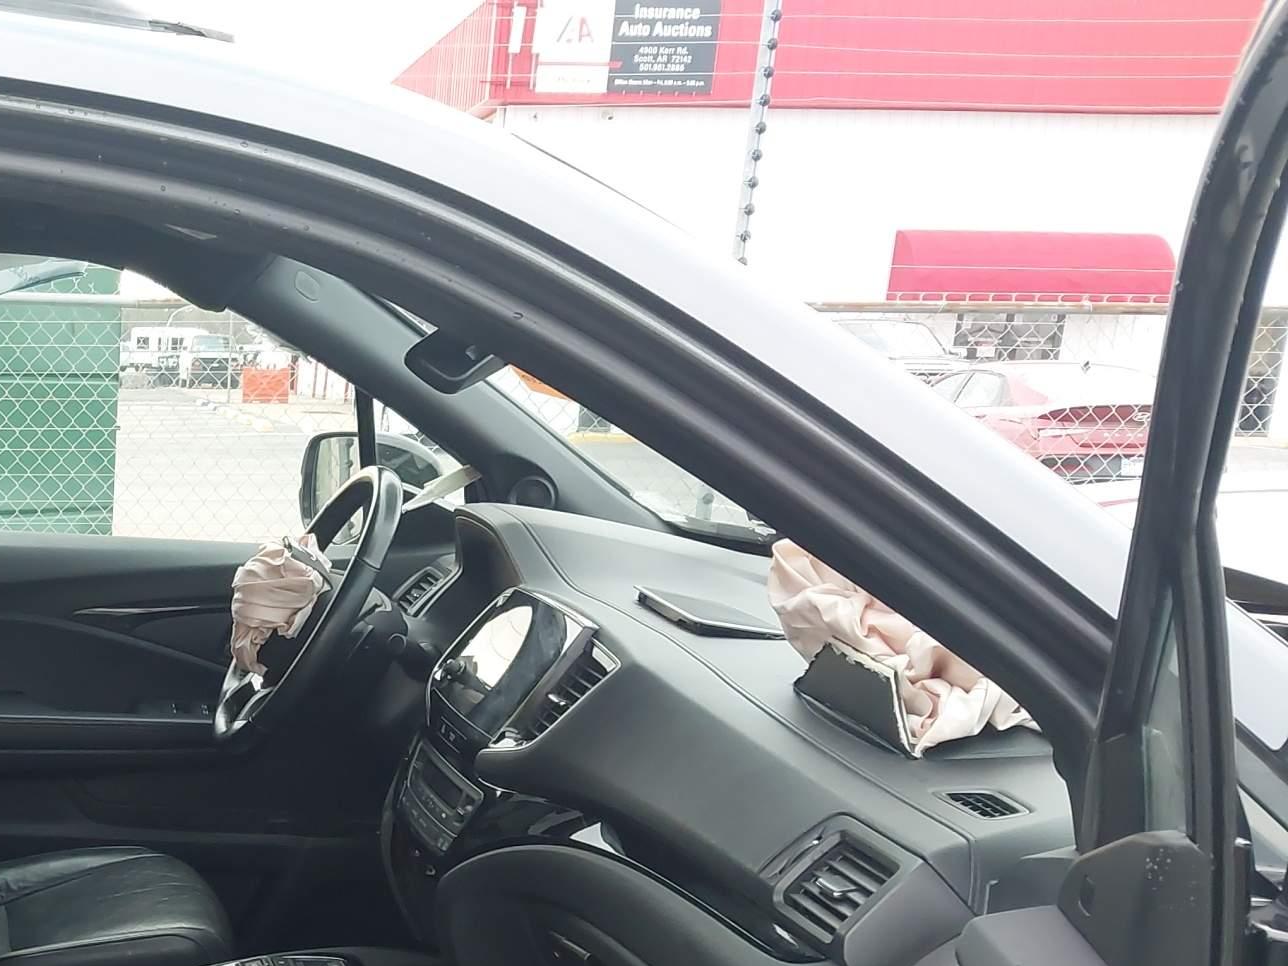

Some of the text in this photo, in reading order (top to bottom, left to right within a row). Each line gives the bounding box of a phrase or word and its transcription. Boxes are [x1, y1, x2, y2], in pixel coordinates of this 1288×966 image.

[634, 3, 701, 19] Insurance
[619, 21, 713, 37] Auto Auctions
[656, 54, 668, 63] AR
